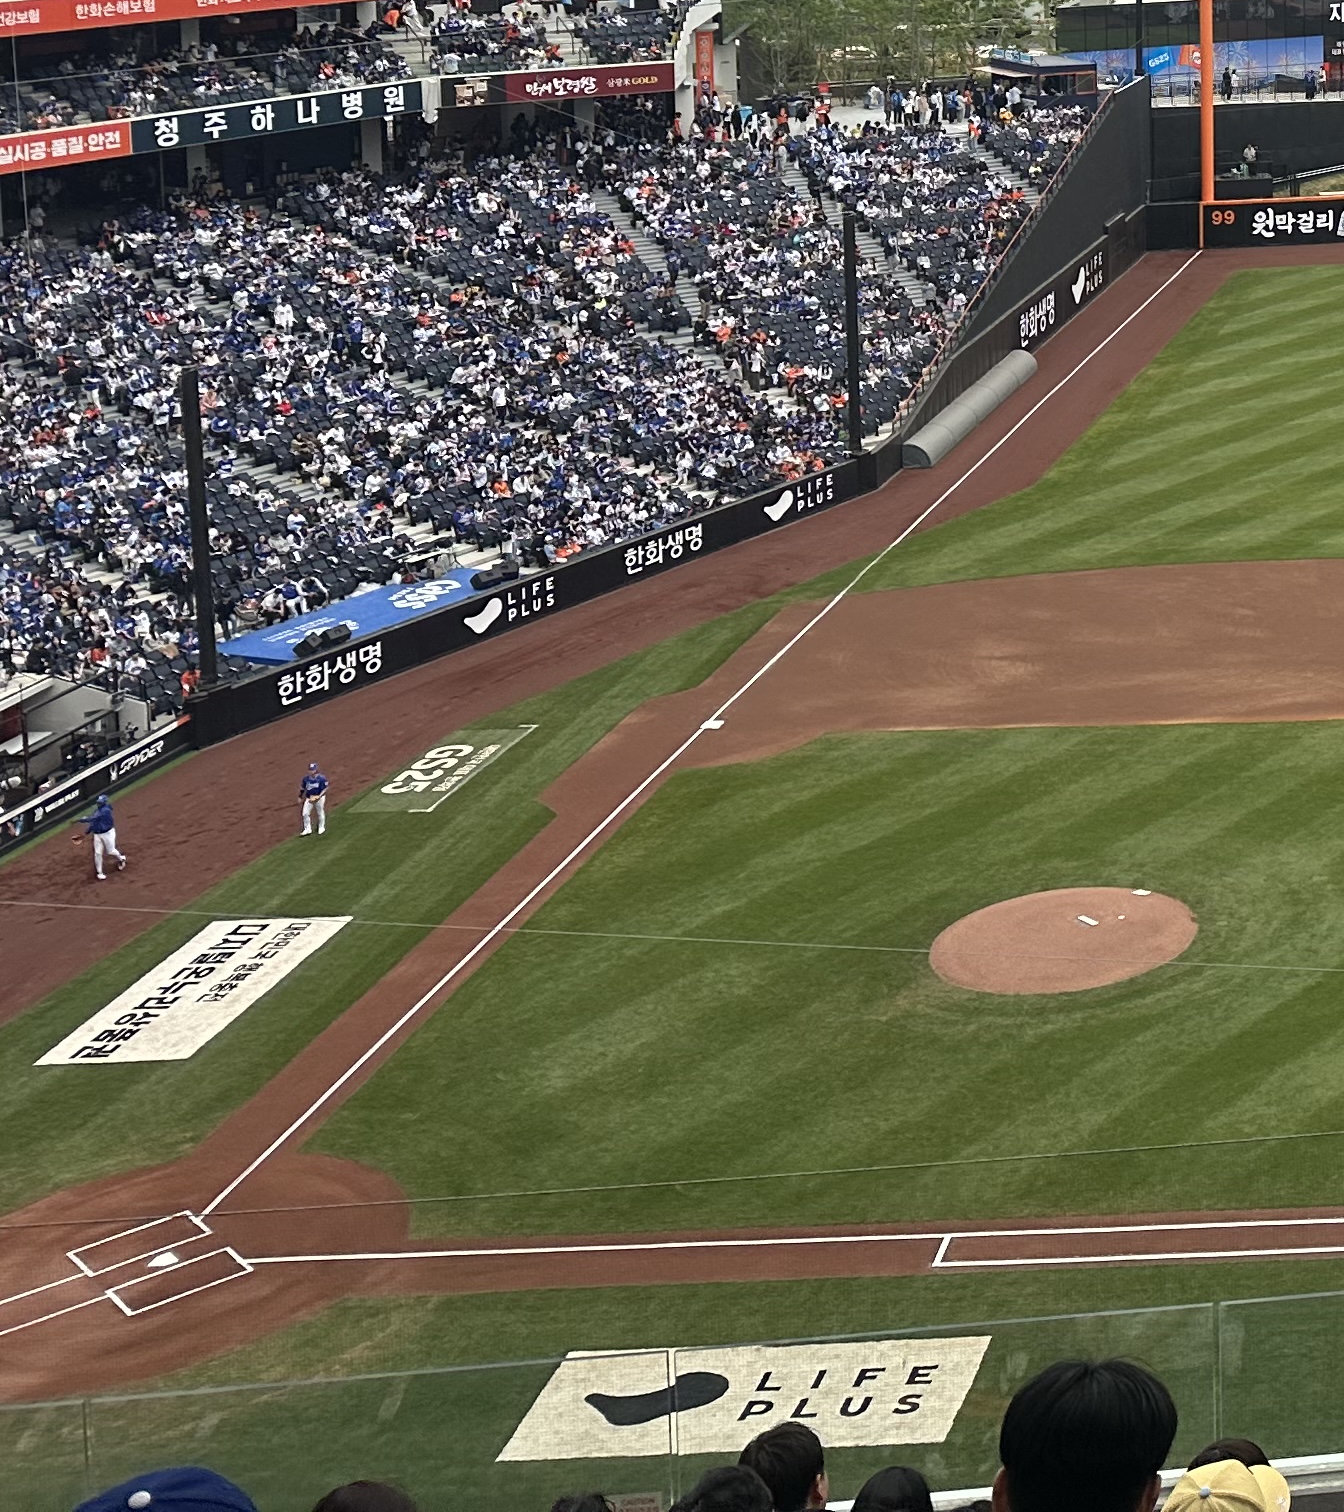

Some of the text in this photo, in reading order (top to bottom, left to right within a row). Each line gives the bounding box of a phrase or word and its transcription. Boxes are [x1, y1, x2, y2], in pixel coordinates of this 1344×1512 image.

[632, 76, 658, 85] GOLD
[1211, 210, 1236, 225] 99
[1251, 207, 1334, 238] 원막걸리
[1085, 251, 1103, 276] LIFE
[1085, 270, 1103, 295] PLUS
[1019, 291, 1055, 347] 한화생명
[797, 474, 834, 497] LIFE
[797, 489, 834, 512] PLUS
[624, 523, 703, 575] 한화생명
[507, 577, 555, 605] LIFE
[507, 594, 555, 622] PLUS
[277, 641, 382, 706] 한화생명
[119, 740, 165, 775] SPYDER
[381, 744, 474, 794] GS25
[196, 922, 312, 1002] 대한민국 행복충전
[69, 924, 270, 1059] 디지털온누리상품권
[755, 1364, 940, 1392] LIFE
[737, 1394, 923, 1422] PLUS
